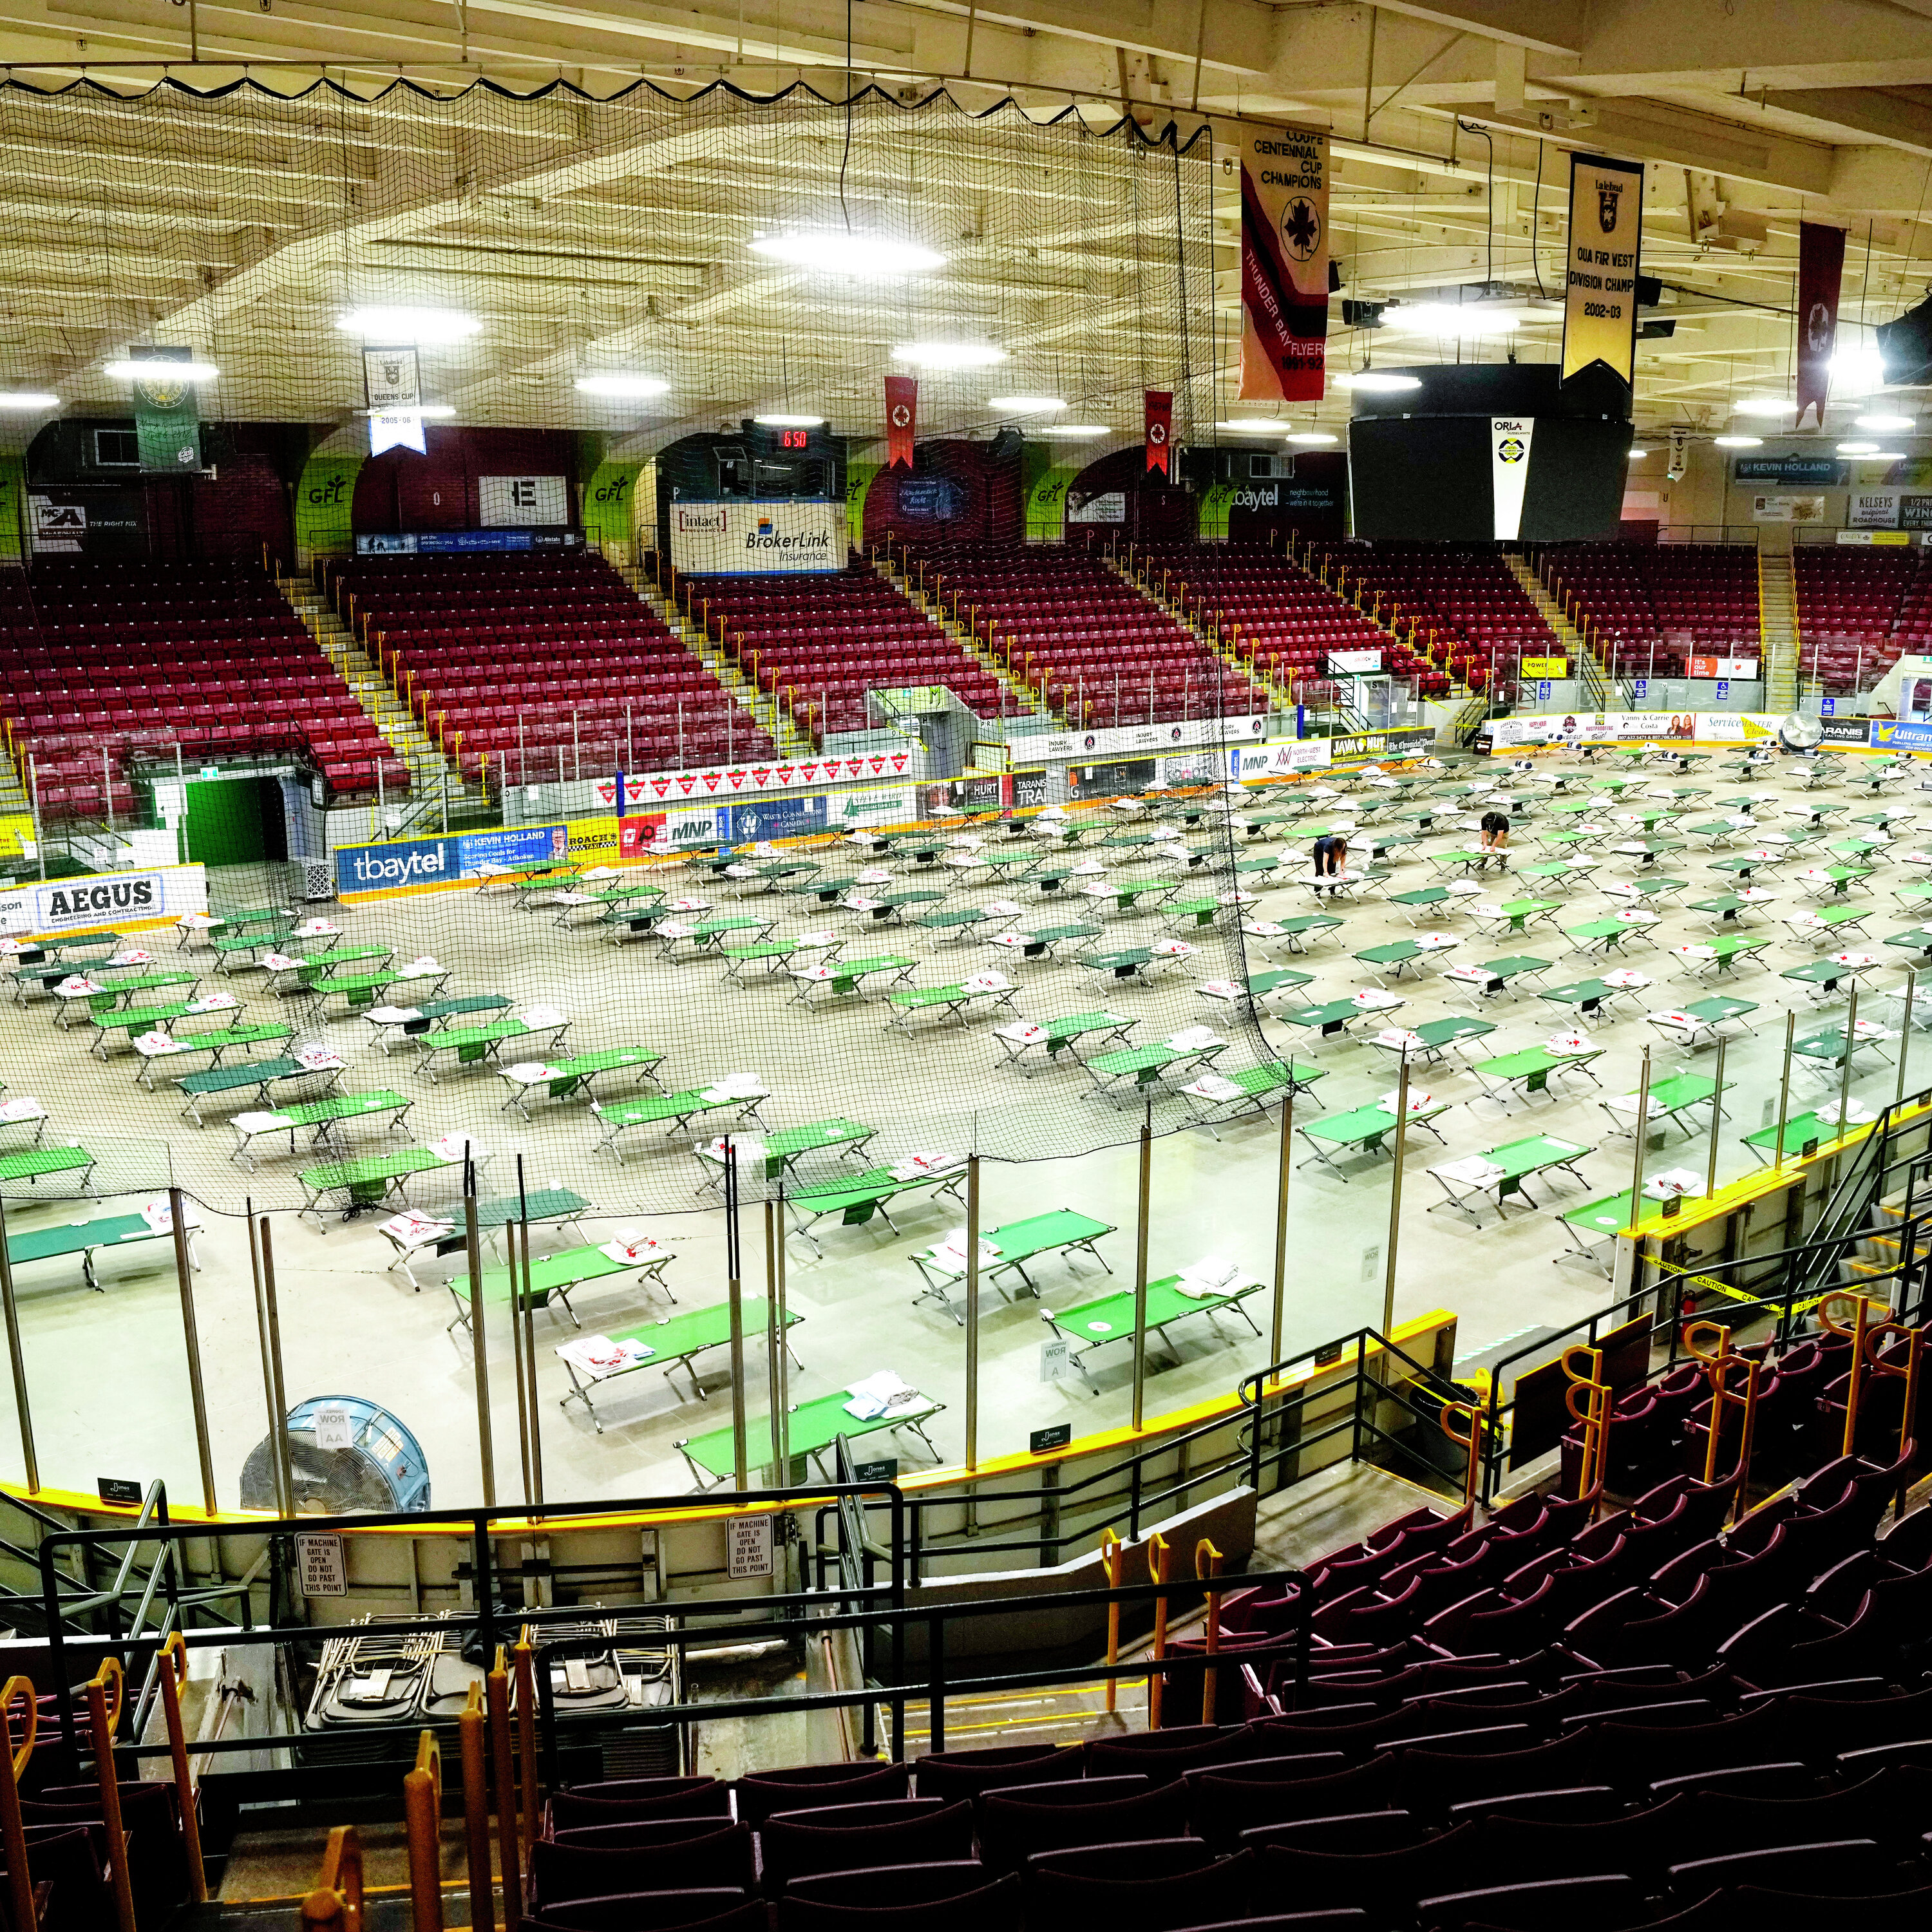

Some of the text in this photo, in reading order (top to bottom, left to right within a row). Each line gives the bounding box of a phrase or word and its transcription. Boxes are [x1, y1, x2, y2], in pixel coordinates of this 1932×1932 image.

[1255, 140, 1318, 159] CENTENNIAL
[1301, 161, 1322, 174] CUP
[1261, 171, 1321, 189] CHAMPIONS
[1578, 247, 1593, 263] OUA
[1612, 254, 1634, 267] WEST
[1569, 270, 1634, 292] DIVISION CHAMP
[1245, 249, 1325, 355] THUNDER BAY FLYER
[1584, 302, 1621, 319] 2002-03
[1495, 422, 1522, 431] ORLA
[309, 484, 343, 504] GFL
[595, 484, 623, 501] GFL
[1037, 488, 1057, 502] GFL
[1231, 484, 1278, 512] baytel
[1859, 497, 1892, 507] KELSEYS
[686, 515, 720, 527] intact
[746, 530, 829, 548] BrokerLink
[780, 550, 827, 561] Insurance
[1823, 727, 1863, 735] ARANIS
[1333, 736, 1385, 755] JAVA HUT
[1389, 742, 1397, 751] The
[1398, 739, 1419, 750] Chronicle
[1243, 756, 1268, 770] MNP
[1297, 755, 1317, 763] ELECTRIC
[974, 783, 997, 796] HURT
[1018, 779, 1046, 790] TARANIS
[782, 809, 823, 818] CONNECTIONS
[672, 820, 712, 840] MNP
[781, 820, 804, 828] CANADA
[475, 837, 501, 846] KEVIN
[504, 831, 545, 843] HOLLAND
[464, 851, 488, 860] Scoring
[354, 843, 445, 884] tbaytel
[464, 858, 490, 867] Thunder
[50, 880, 152, 916] AEGUS
[0, 902, 22, 912] son
[52, 913, 91, 923] ENGINEERING
[108, 906, 152, 914] CONTRACTING
[1654, 1260, 1682, 1274] CAUTION
[1697, 1276, 1727, 1293] CAUTION
[1797, 1299, 1820, 1311] CAUTION
[1041, 1432, 1060, 1442] Jones
[864, 1466, 885, 1475] Jones
[110, 1482, 129, 1492] Jones
[739, 1519, 768, 1529] MACHINE
[308, 1539, 338, 1547] MACHINE
[748, 1546, 761, 1554] NOT
[748, 1554, 763, 1563] PAST
[732, 1564, 768, 1574] THIS POINT
